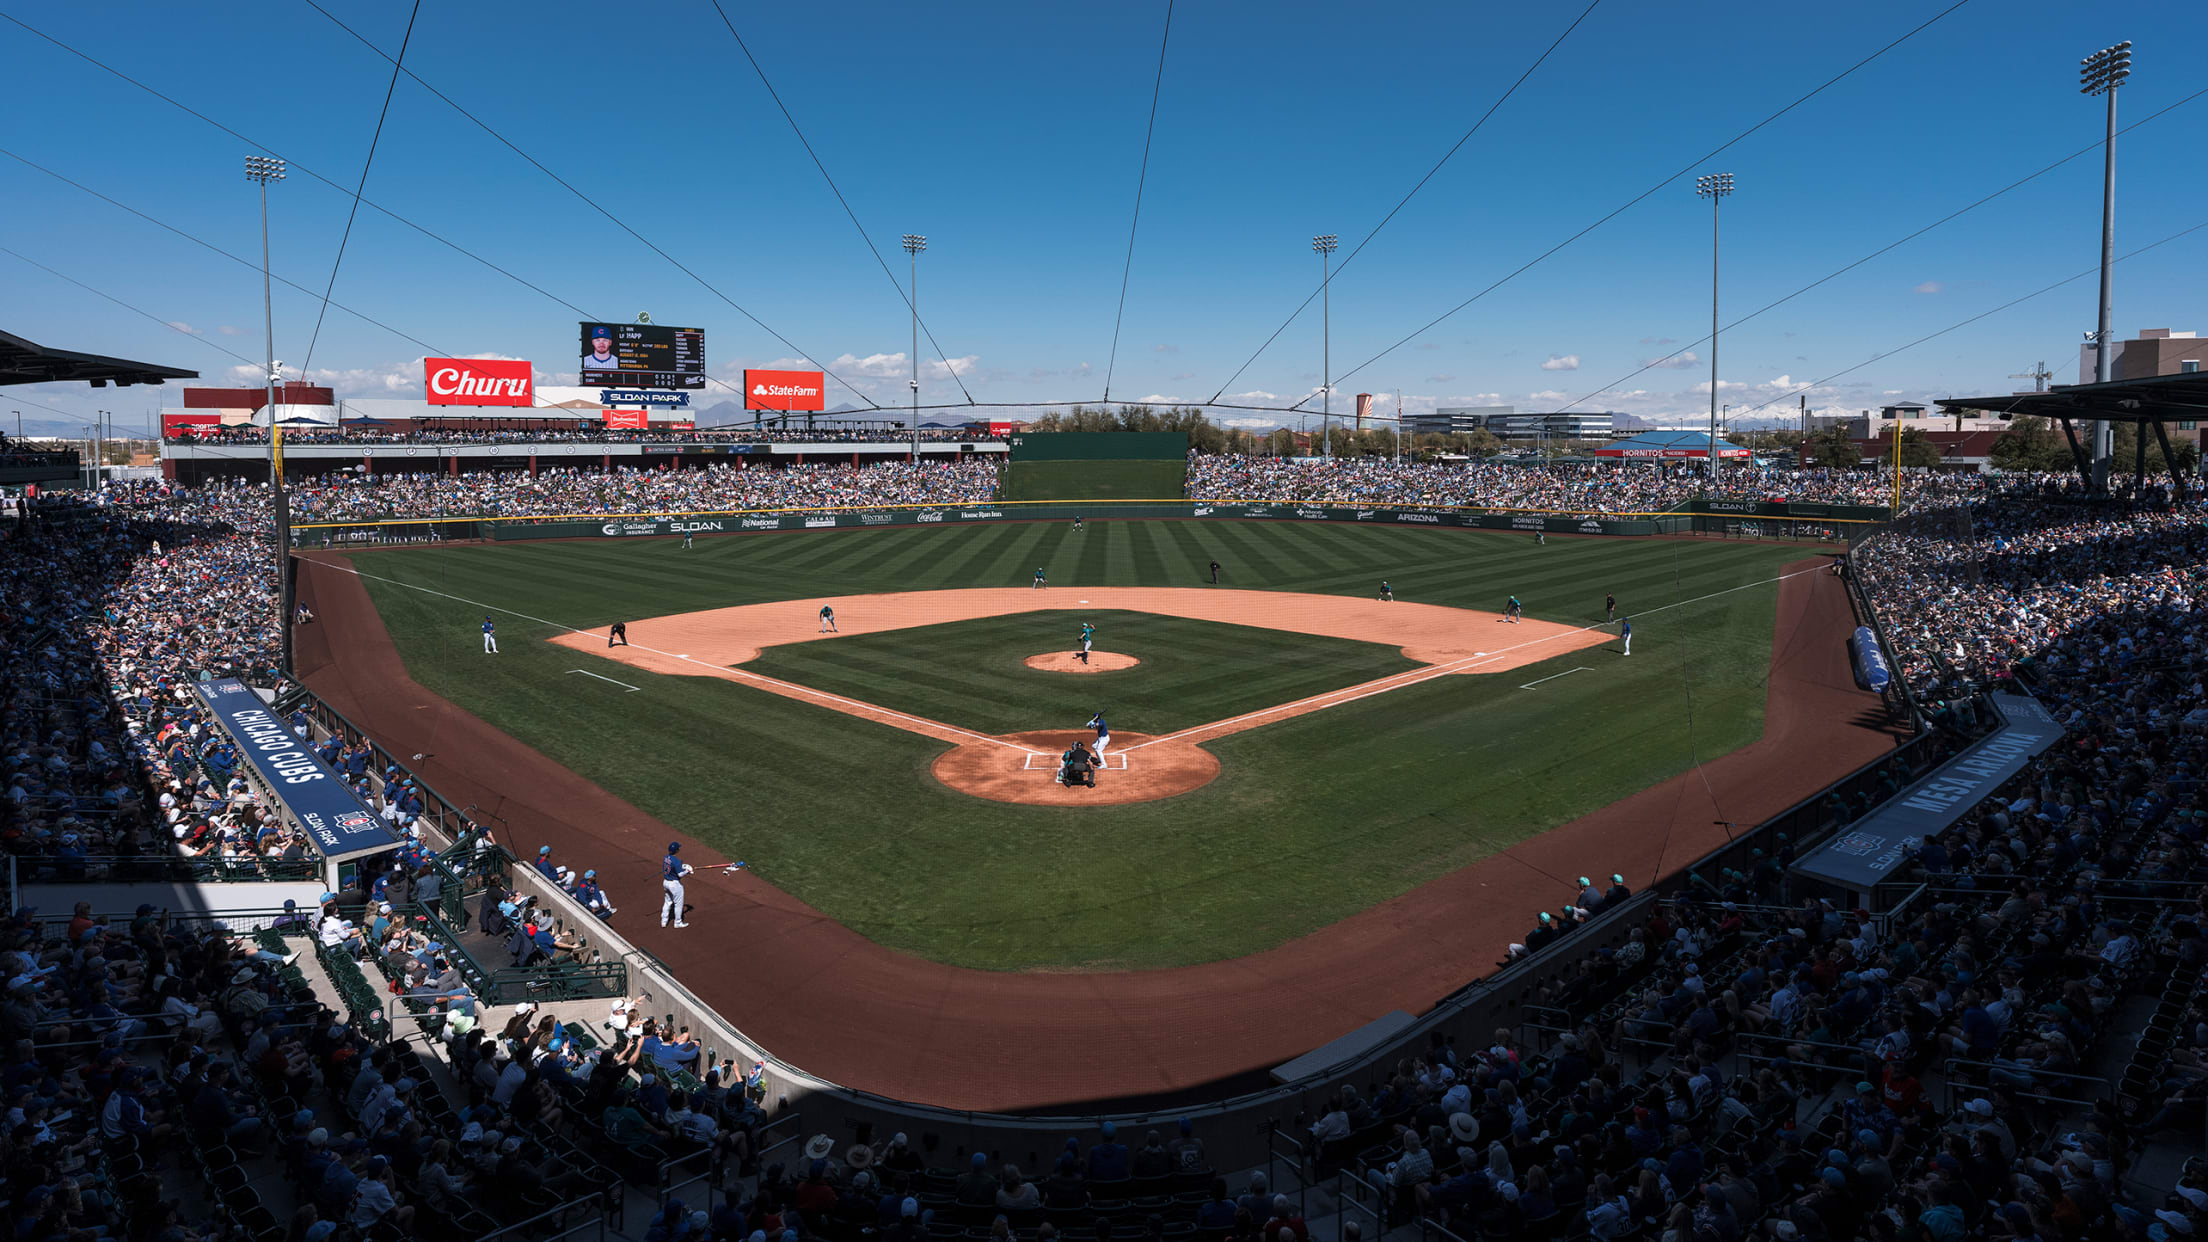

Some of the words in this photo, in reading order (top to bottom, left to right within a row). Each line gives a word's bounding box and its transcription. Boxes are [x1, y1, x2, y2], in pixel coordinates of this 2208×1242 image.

[431, 367, 527, 397] Churu
[610, 393, 650, 401] SLOAN
[652, 394, 682, 402] PARK
[1622, 449, 1664, 457] HORNITOS
[1397, 513, 1439, 522] ARIZONA
[1512, 517, 1544, 525] HORNITOS
[623, 522, 657, 530] Gallagher
[670, 521, 722, 532] SLOAN
[751, 518, 779, 527] National
[231, 709, 295, 751] CHICAGO
[267, 751, 325, 784] CUBS
[1901, 776, 1983, 813] MESA
[1954, 732, 2042, 778] ARIZONA
[303, 812, 328, 834] SLOAN
[319, 829, 340, 847] PARK
